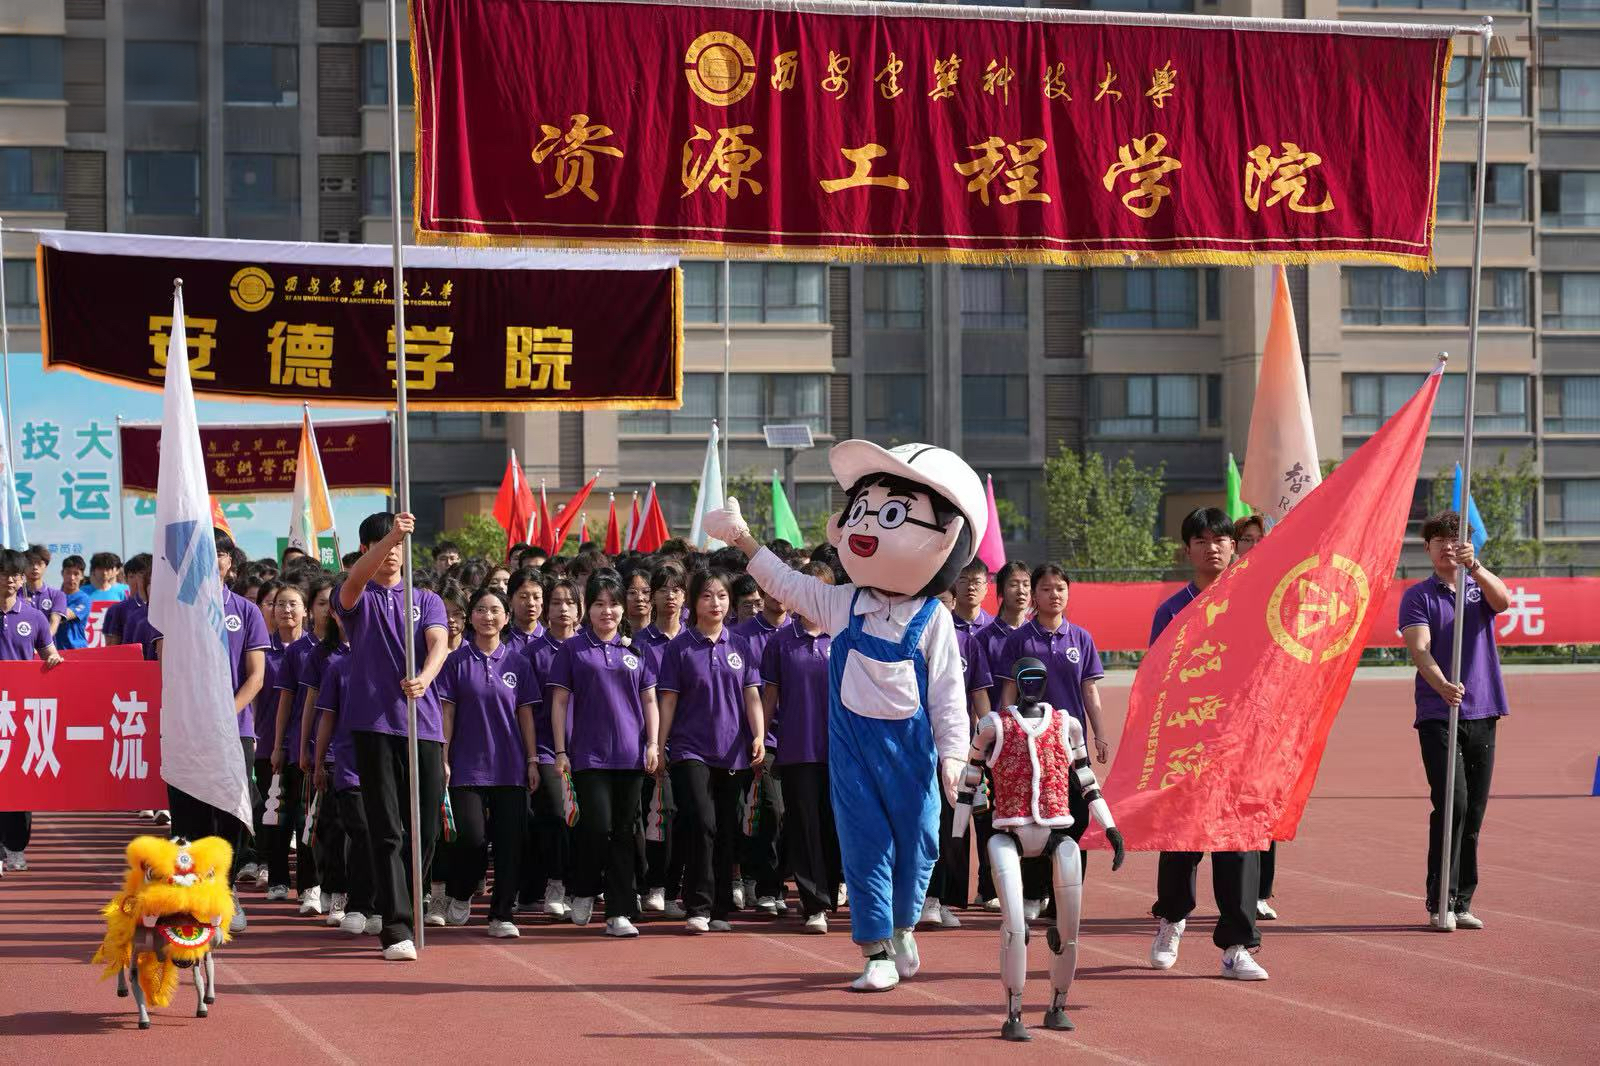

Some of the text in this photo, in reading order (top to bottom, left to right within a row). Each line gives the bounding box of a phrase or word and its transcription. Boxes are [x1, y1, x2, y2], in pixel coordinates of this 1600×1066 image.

[532, 113, 1336, 218] 资源工程学院
[148, 315, 573, 390] 安德学院
[22, 421, 113, 460] 技大
[1499, 586, 1544, 638] 先
